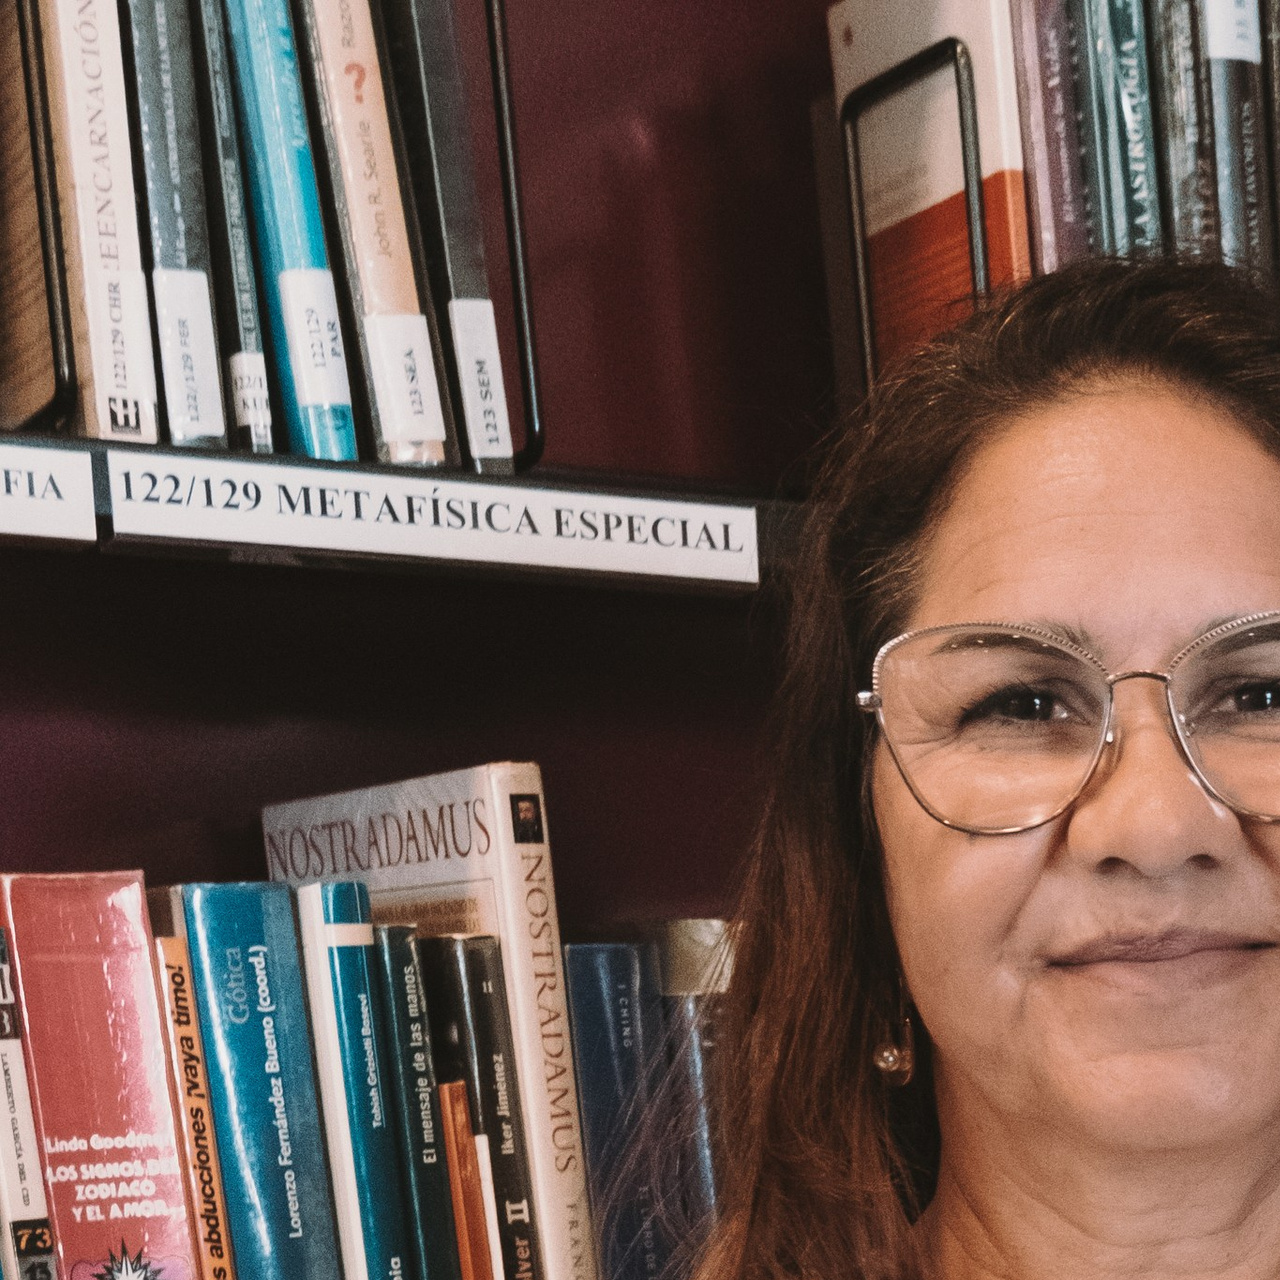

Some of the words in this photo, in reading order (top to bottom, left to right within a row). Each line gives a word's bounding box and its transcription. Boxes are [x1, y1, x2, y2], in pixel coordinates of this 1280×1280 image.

[355, 120, 380, 183] Searle
[373, 225, 393, 258] John
[476, 358, 494, 402] SEM
[484, 409, 500, 445] 123
[2, 468, 64, 501] FIA
[120, 470, 263, 512] 122/129
[277, 486, 541, 537] METAFÍSICA
[553, 508, 745, 554] ESPECIAL
[265, 798, 491, 882] NOSTRADAMUS
[166, 963, 191, 1027] timo!
[223, 946, 250, 1024] Gótica
[248, 944, 277, 1013] (coord.)
[403, 965, 421, 1018] manos
[407, 1020, 423, 1048] las
[520, 851, 580, 1174] NOSTRADAMUS
[177, 1035, 207, 1099] ¡vaya
[262, 1014, 281, 1074] Bueno
[411, 1051, 427, 1075] de
[490, 1053, 512, 1115] Jiménez
[269, 1077, 293, 1167] Fernández
[413, 1081, 435, 1145] mensaje
[500, 1117, 516, 1155] Iker
[46, 1136, 88, 1154] Linda
[46, 1165, 78, 1183] LOS
[80, 1159, 143, 1180] SIGNOS
[421, 1149, 438, 1166] El
[21, 1185, 32, 1208] CID
[74, 1179, 156, 1201] ZODIACO
[189, 1110, 225, 1260] abducciones
[278, 1171, 304, 1239] Lorenzo
[17, 1228, 52, 1251] 73
[71, 1206, 84, 1223] Y
[86, 1204, 105, 1222] EL
